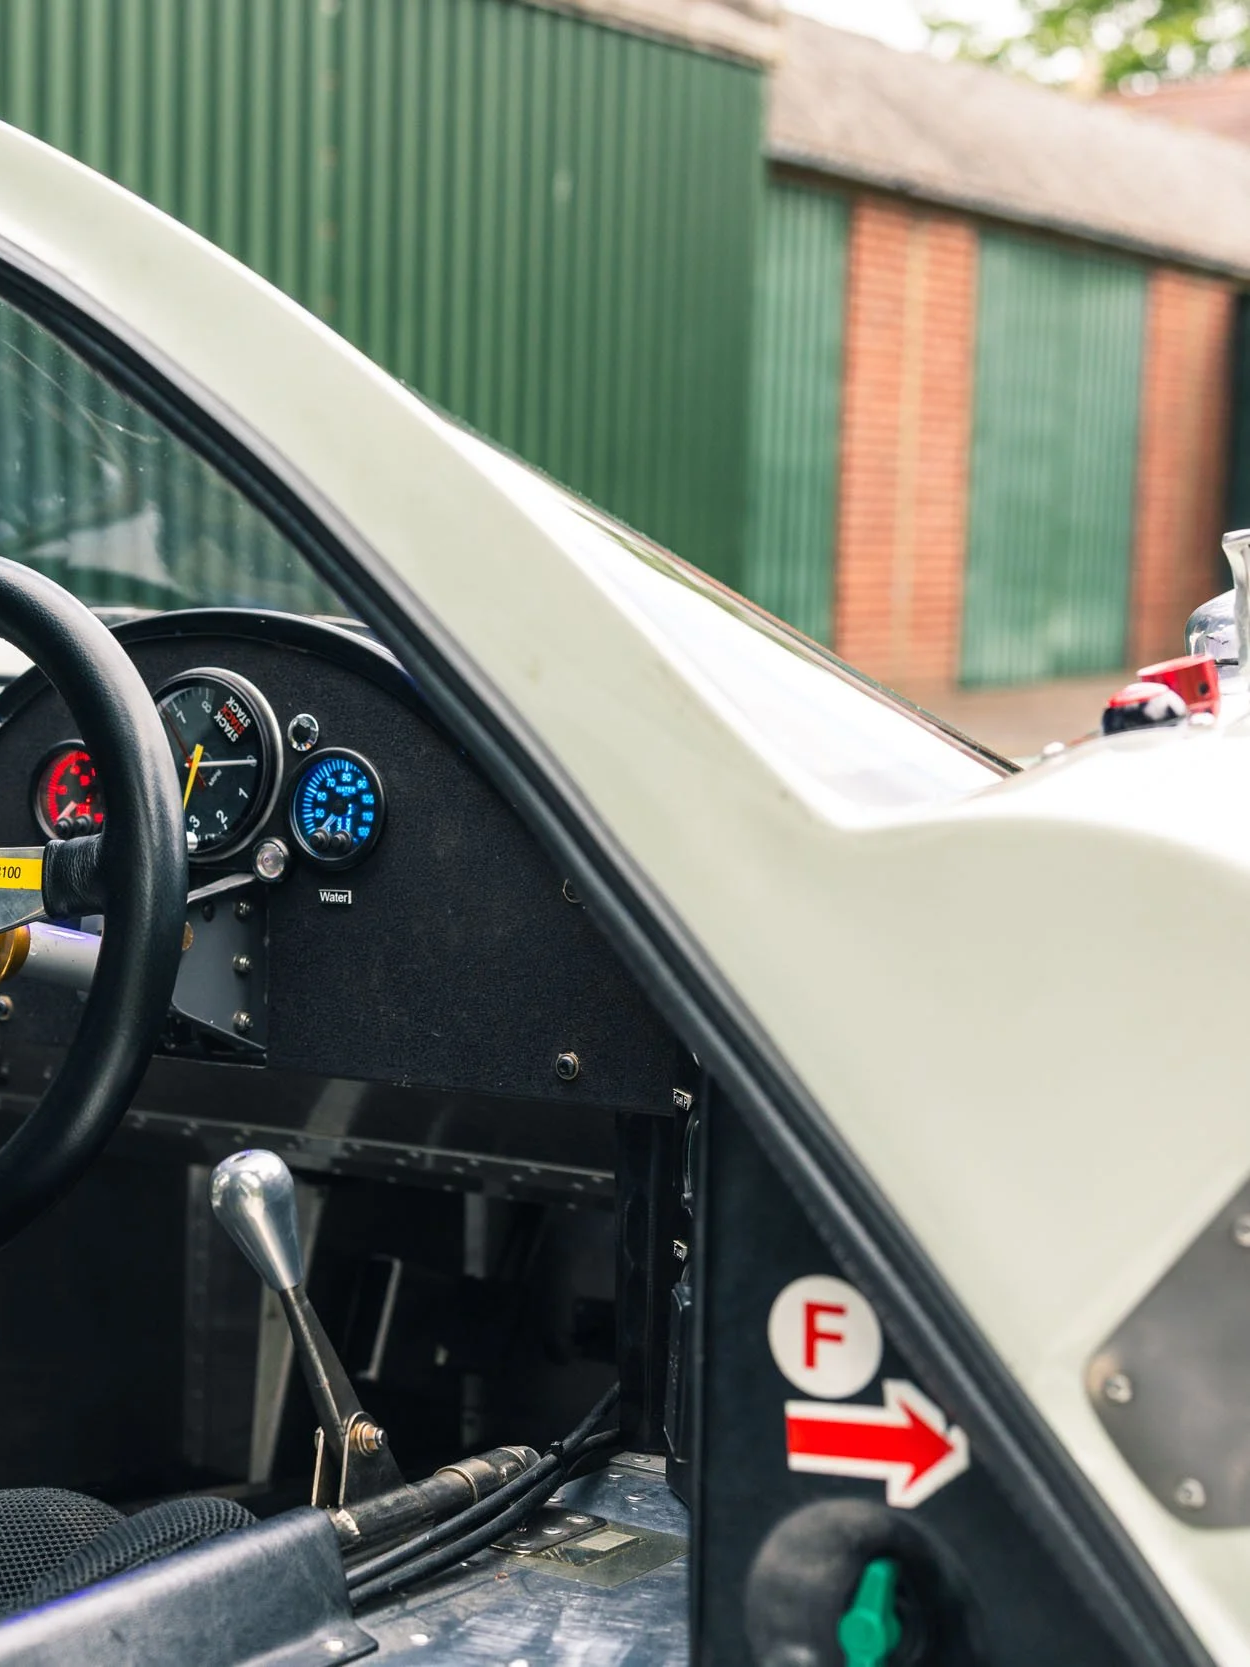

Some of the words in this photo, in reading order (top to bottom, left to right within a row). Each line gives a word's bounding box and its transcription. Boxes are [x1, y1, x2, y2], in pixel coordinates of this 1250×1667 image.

[201, 701, 211, 714] 8
[227, 696, 251, 728] STACK
[176, 711, 187, 724] 7
[220, 705, 245, 736] STACK
[214, 711, 239, 743] STACK
[327, 778, 336, 788] 70
[356, 780, 367, 789] 90
[238, 787, 249, 799] 1
[189, 815, 200, 828] 3
[216, 810, 228, 824] 2
[319, 891, 348, 903] Water
[804, 1301, 846, 1369] F
